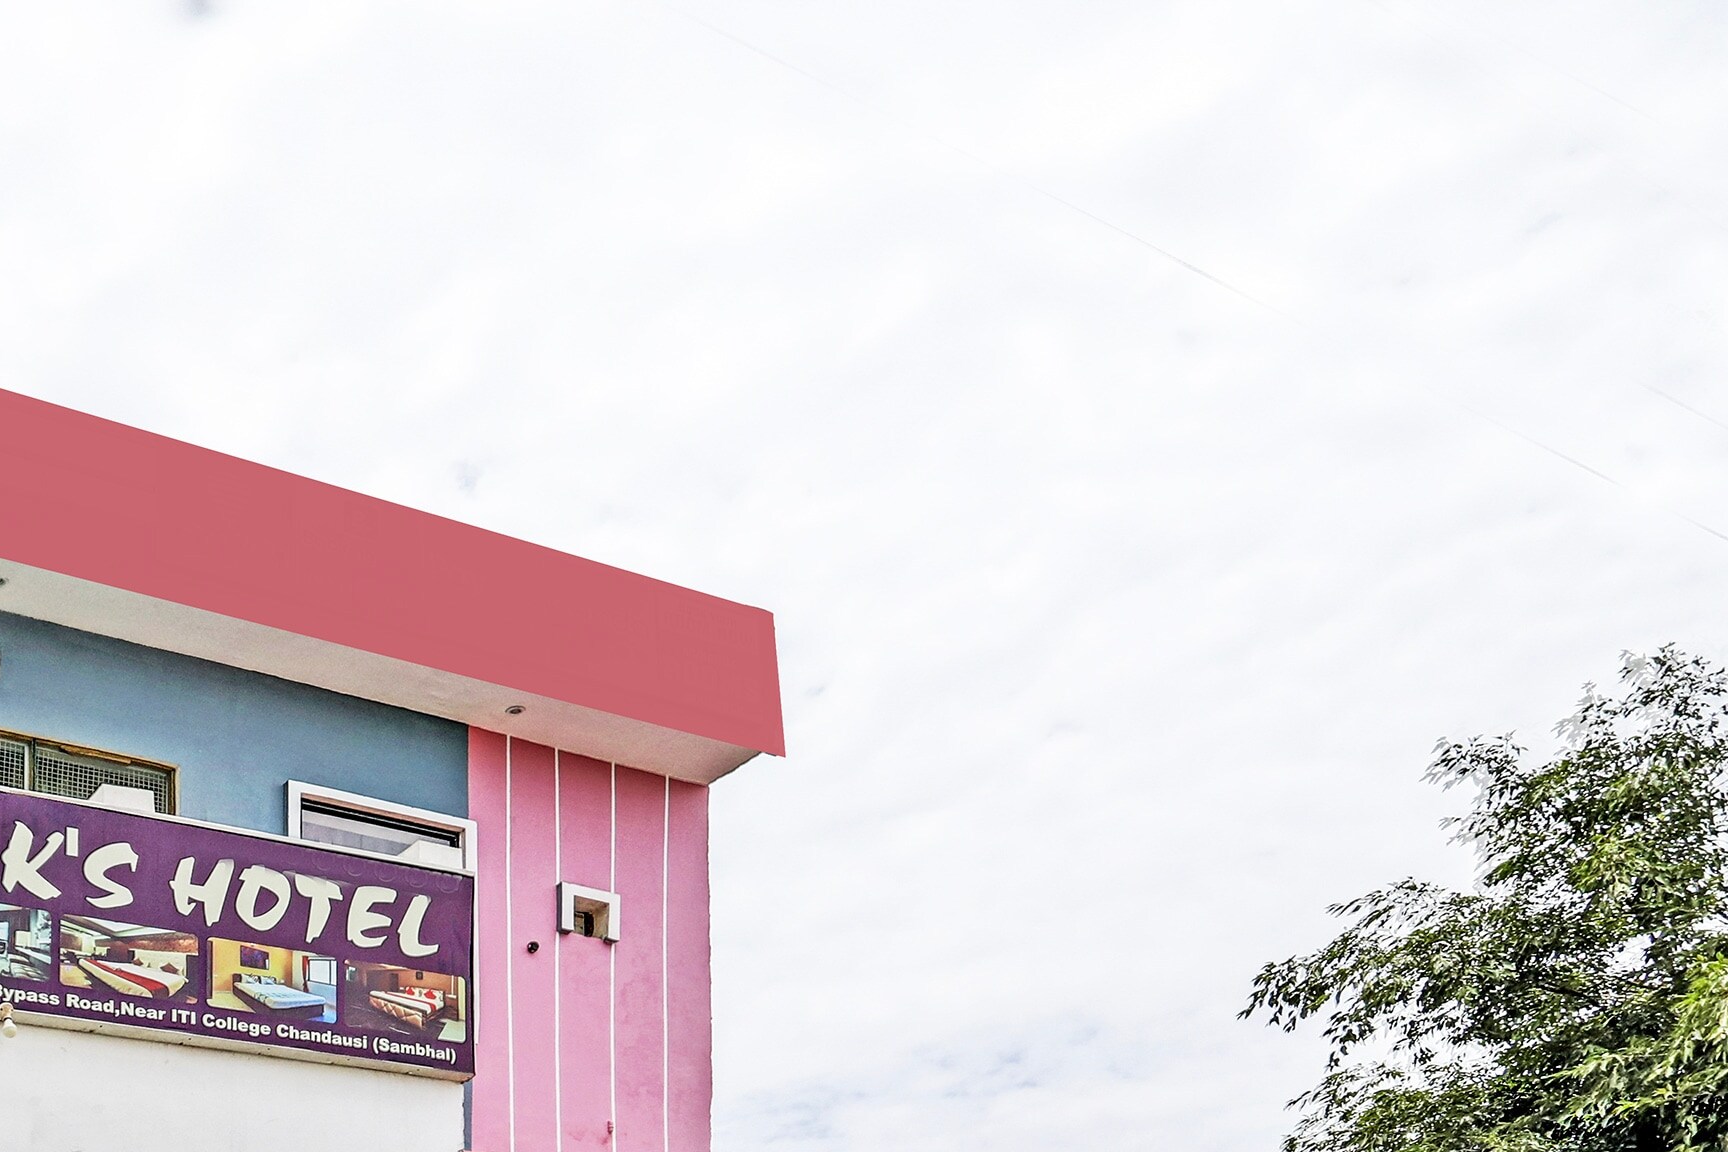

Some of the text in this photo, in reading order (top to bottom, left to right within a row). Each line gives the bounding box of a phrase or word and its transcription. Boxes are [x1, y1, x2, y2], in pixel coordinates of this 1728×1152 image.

[168, 855, 440, 958] HOTEL
[170, 1008, 197, 1026] ITI
[203, 1013, 272, 1037] College
[276, 1023, 368, 1050] Chandausi
[371, 1036, 458, 1064] (Sambhal)
